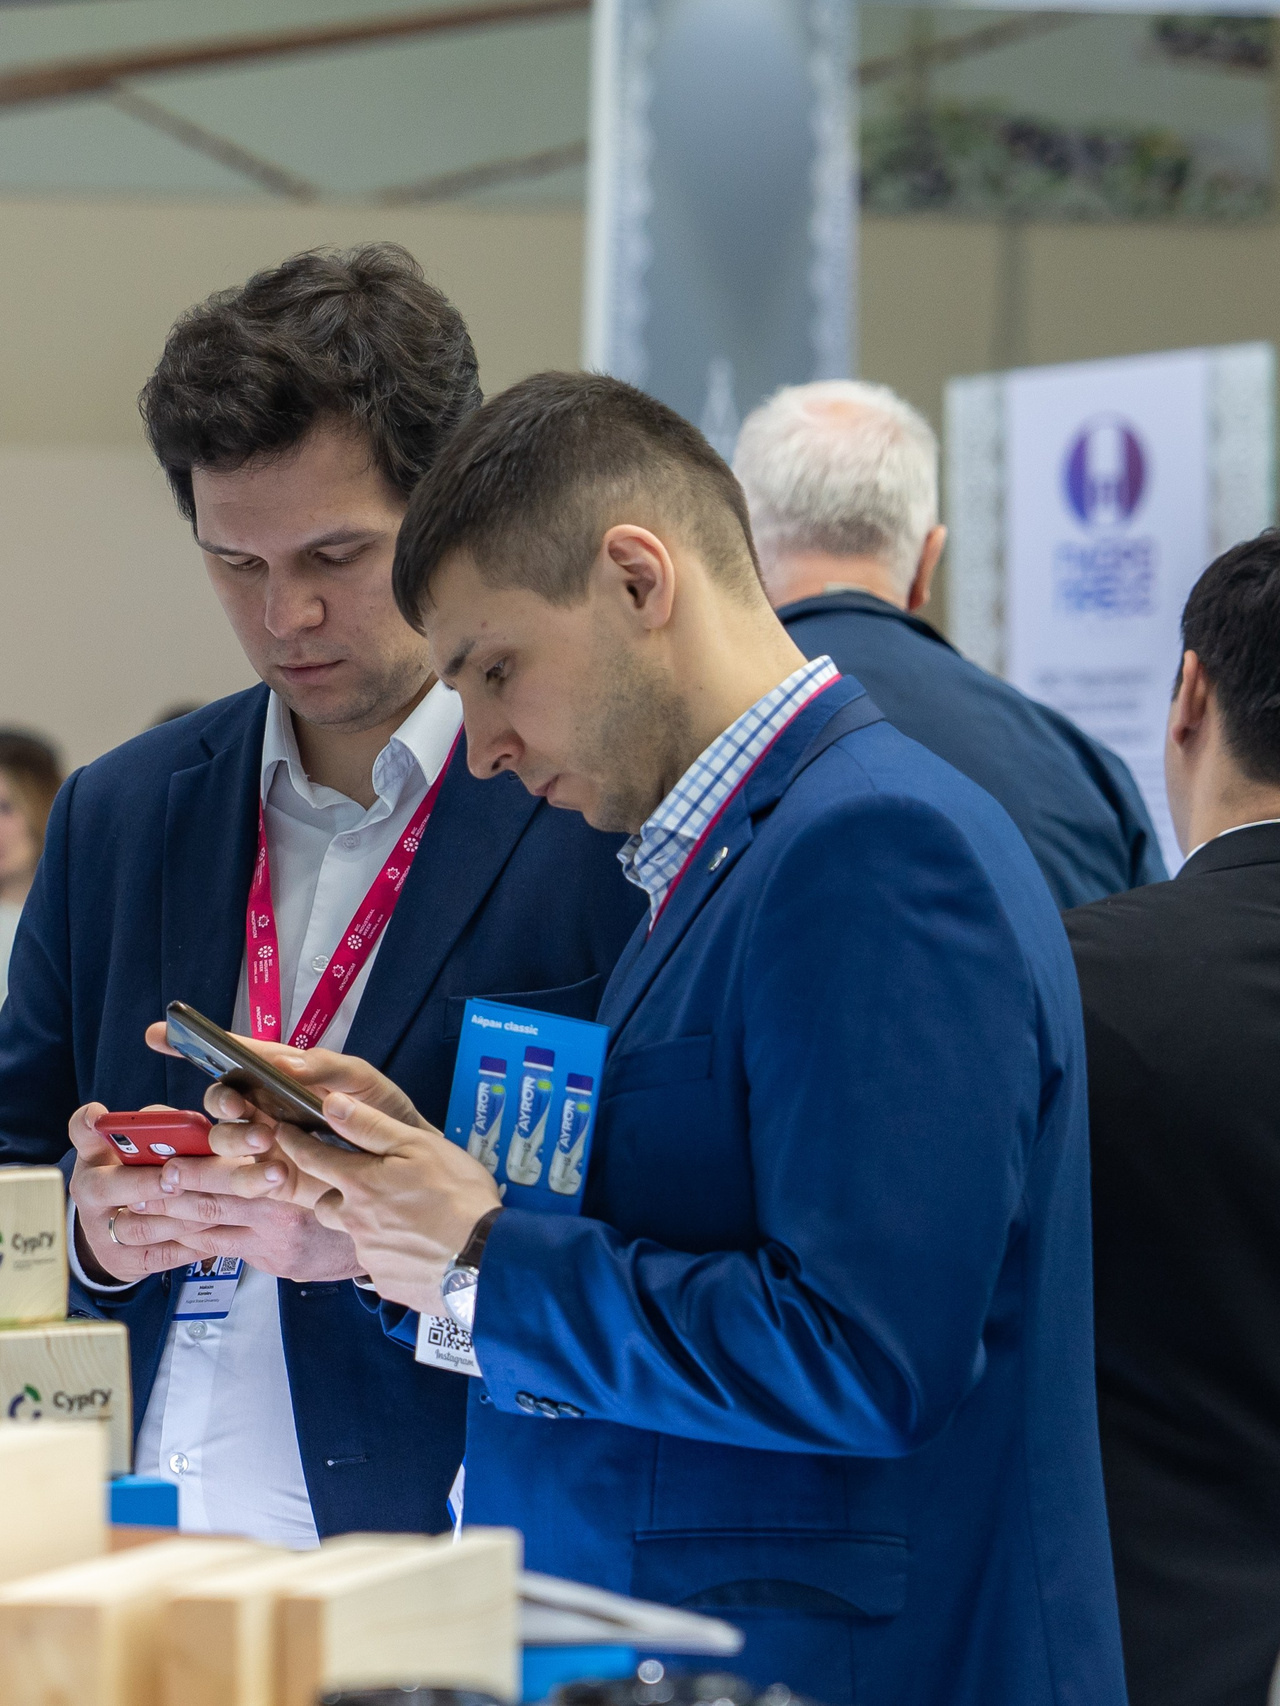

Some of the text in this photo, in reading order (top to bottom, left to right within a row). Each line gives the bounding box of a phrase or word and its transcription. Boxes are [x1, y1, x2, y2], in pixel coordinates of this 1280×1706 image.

[358, 908, 376, 934] INDUSTRIAL
[362, 923, 373, 936] WEEK
[338, 963, 356, 991] INNOPROM
[255, 1006, 263, 1033] INNOPROM
[503, 1021, 539, 1036] classic
[475, 1081, 491, 1131] AYRON
[518, 1075, 537, 1132] AYRON
[560, 1098, 577, 1149] AYRON
[12, 1231, 55, 1254] СурГУ
[434, 1348, 475, 1367] Instagram
[52, 1388, 113, 1413] СурГУ
